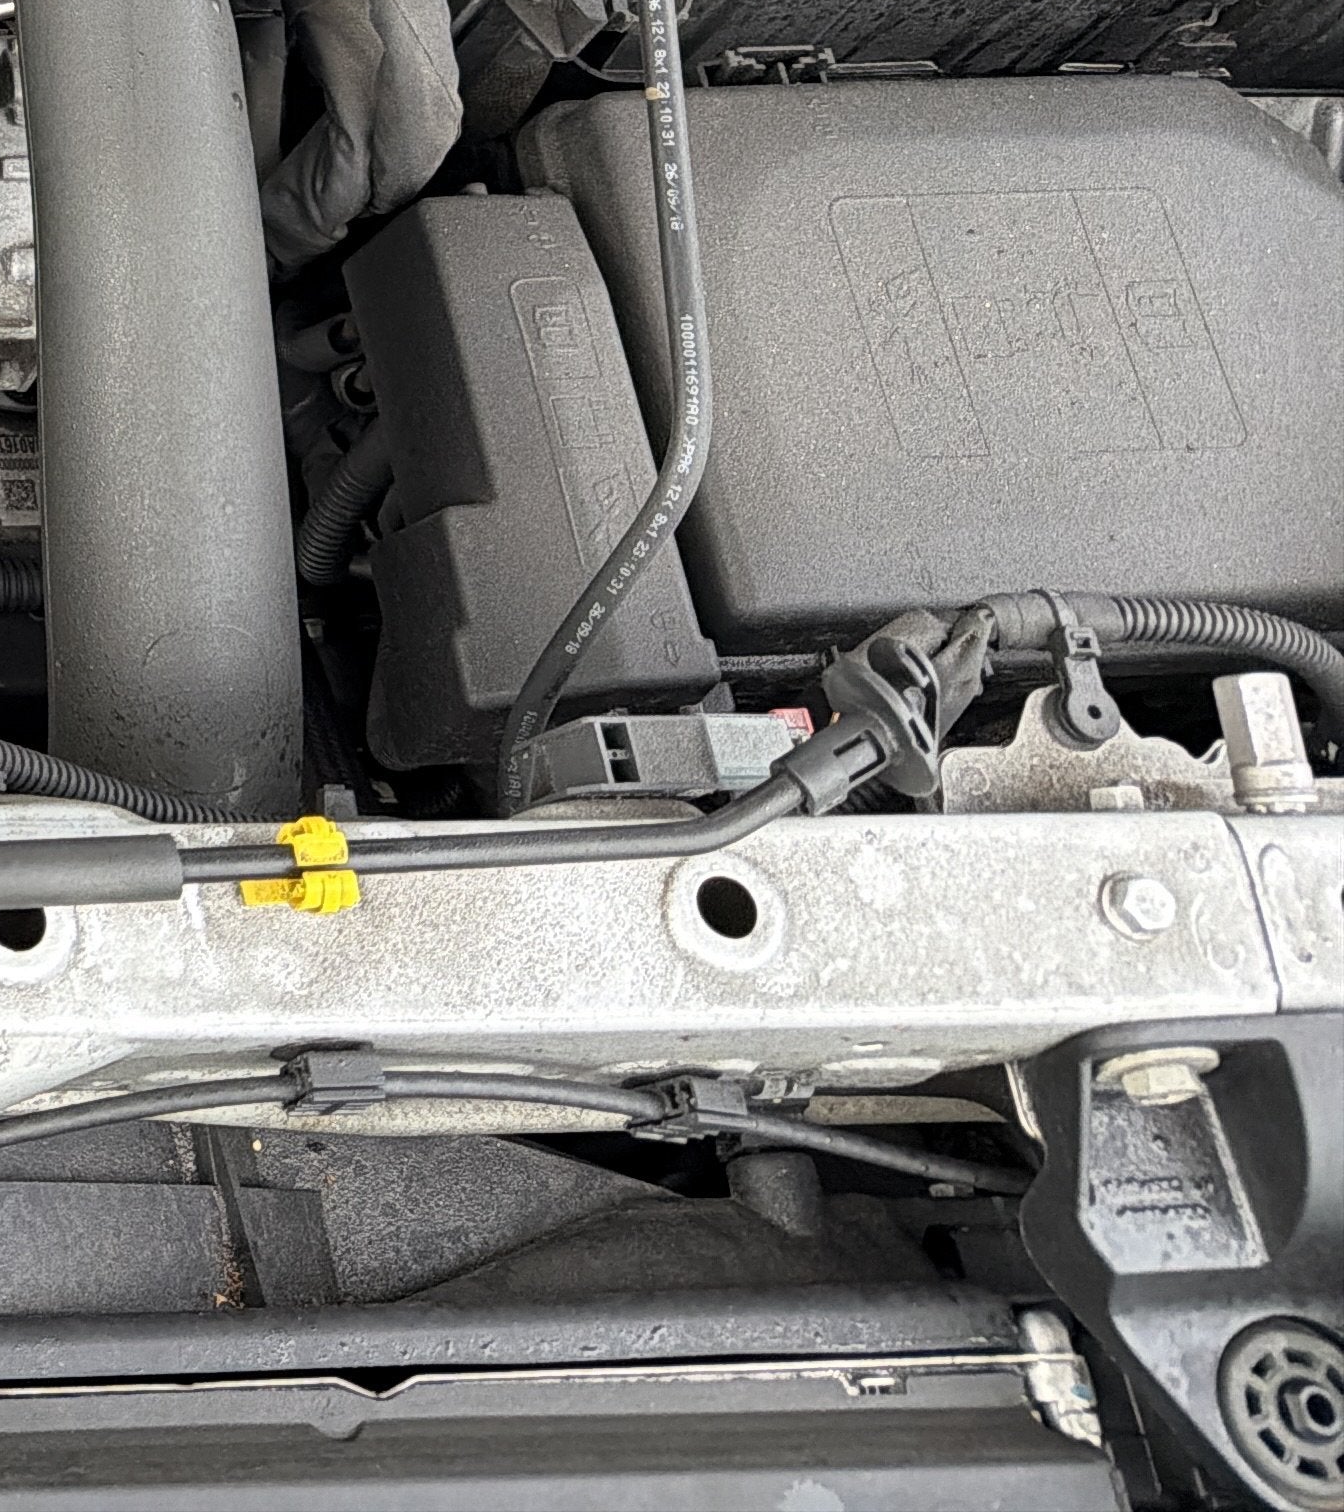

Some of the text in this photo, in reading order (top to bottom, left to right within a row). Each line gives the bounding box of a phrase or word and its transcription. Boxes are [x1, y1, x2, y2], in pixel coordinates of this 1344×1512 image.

[652, 48, 669, 74] 8x1
[679, 313, 699, 424] 1000011691A0
[644, 511, 673, 540] 8x1
